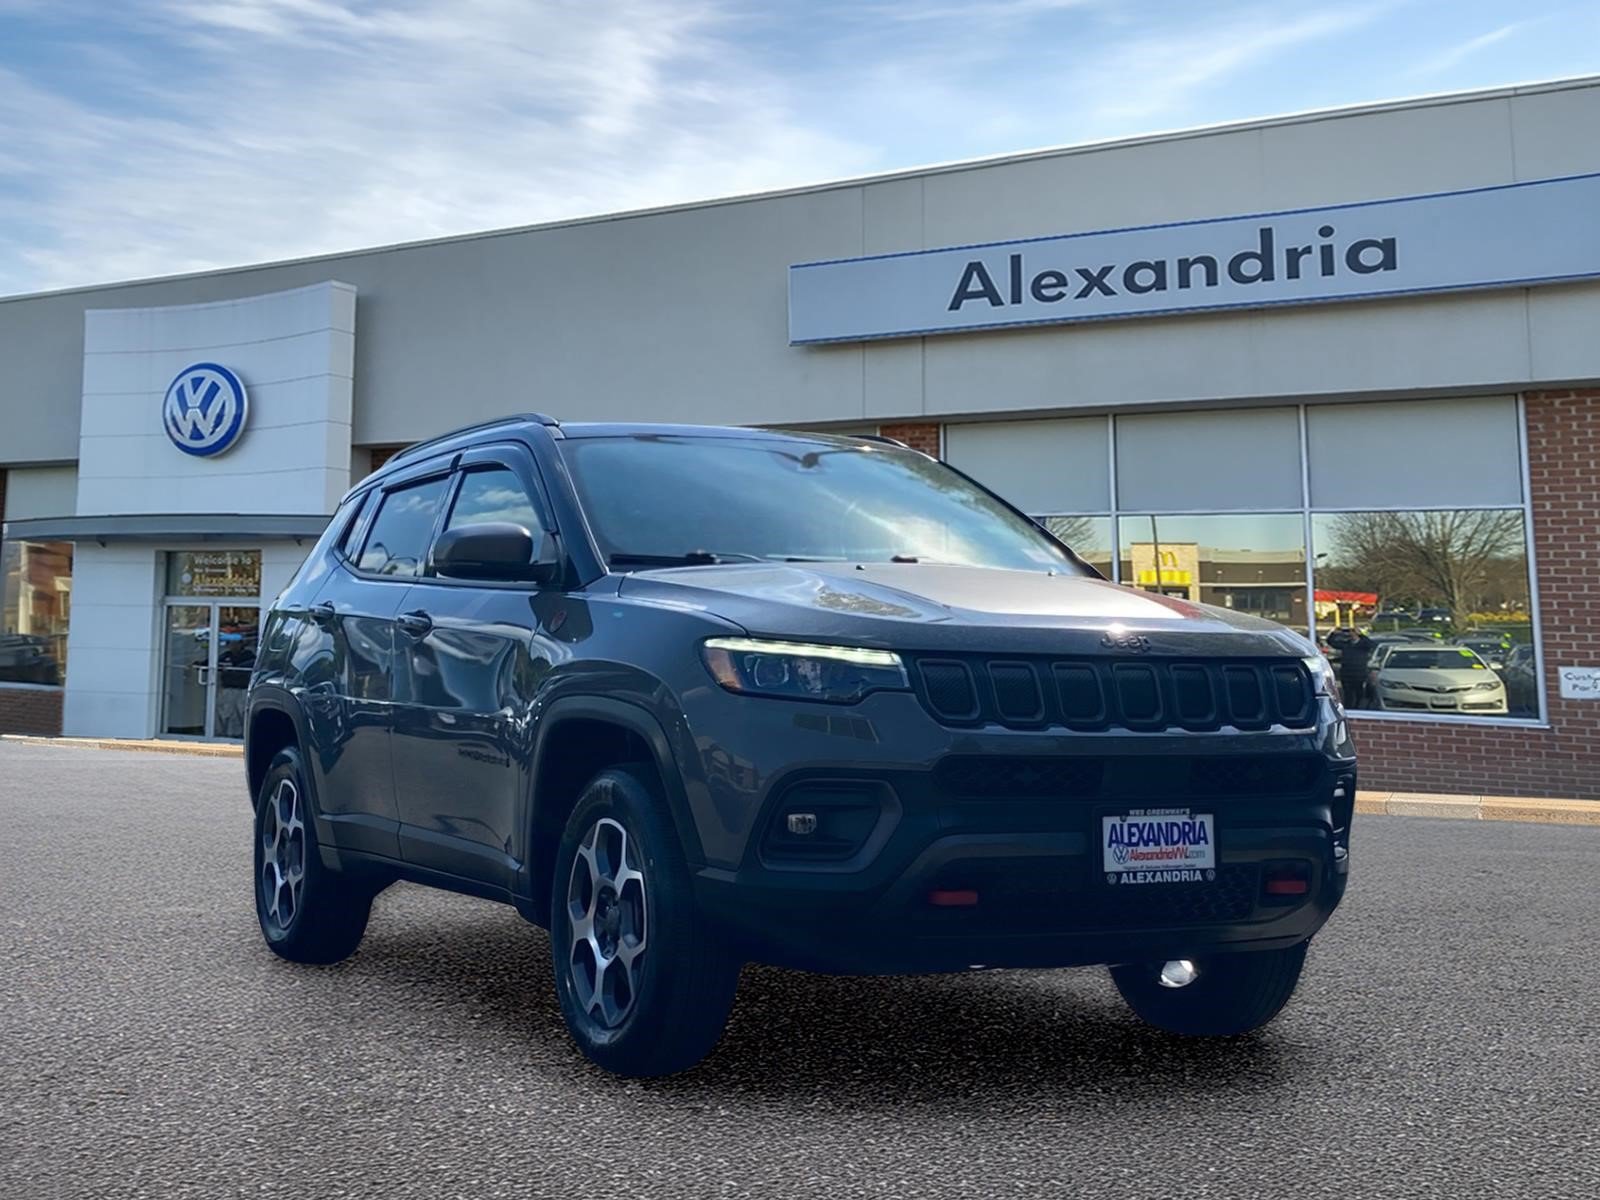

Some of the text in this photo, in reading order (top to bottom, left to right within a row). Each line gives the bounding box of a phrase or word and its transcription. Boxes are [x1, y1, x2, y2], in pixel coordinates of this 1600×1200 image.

[947, 225, 1398, 312] Alexandria
[1101, 631, 1152, 653] Jeep
[1107, 820, 1209, 848] ALEXANDRIA
[1120, 870, 1203, 884] ALEXANDRIA
